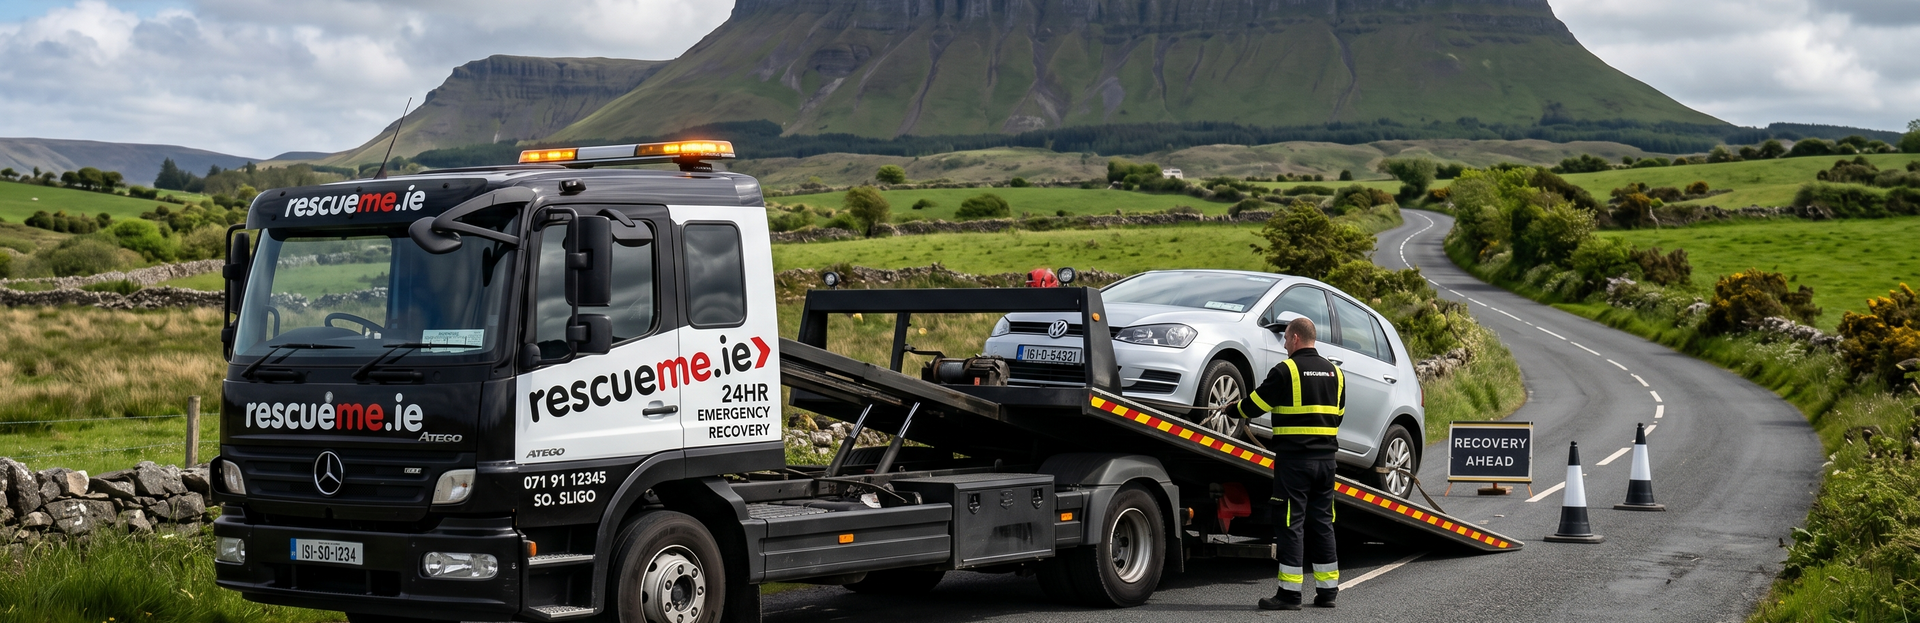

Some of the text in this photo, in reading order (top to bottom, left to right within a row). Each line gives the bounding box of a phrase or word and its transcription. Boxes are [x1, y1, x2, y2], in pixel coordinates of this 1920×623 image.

[285, 185, 425, 217] rescueme.ie
[1026, 348, 1077, 362] 161-D-54321
[528, 334, 752, 423] rescueme.ie
[721, 383, 769, 403] 24HR
[246, 392, 423, 431] rescueme.ie
[697, 406, 771, 421] EMERGENCY
[418, 431, 463, 442] ATEGO
[708, 423, 770, 438] RECOVERY
[1454, 437, 1527, 449] RECOVERY
[526, 448, 565, 459] ATEGO
[1465, 456, 1514, 467] AHEAD
[523, 471, 606, 489] 071 91 12345
[534, 491, 596, 507] SO. SLIGO
